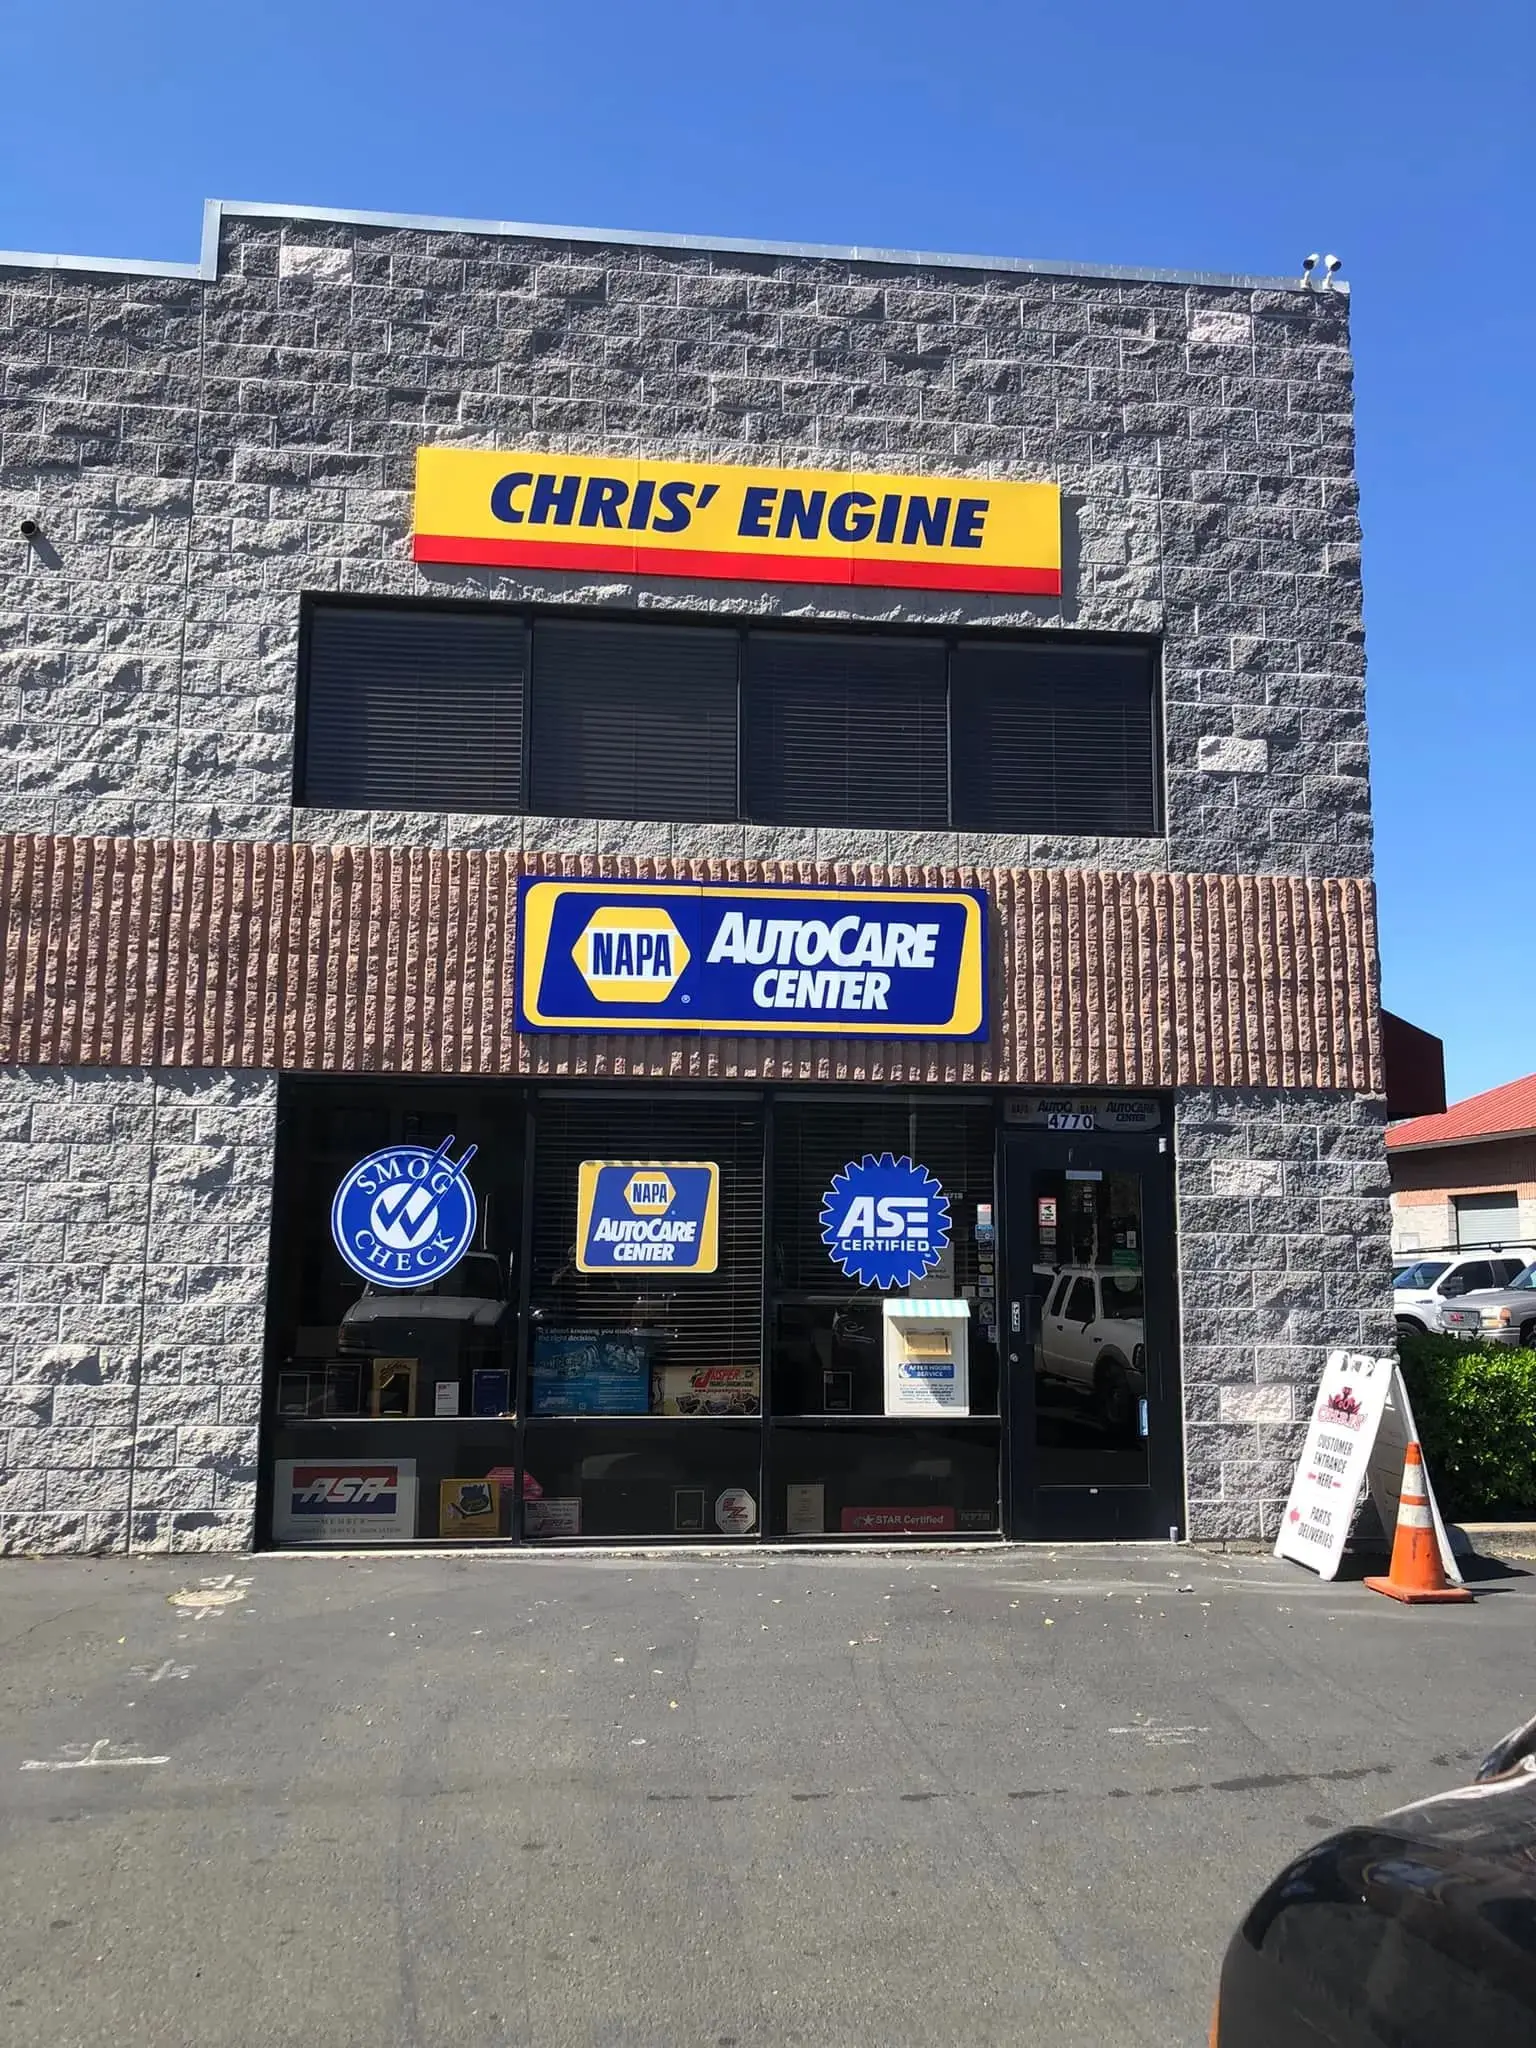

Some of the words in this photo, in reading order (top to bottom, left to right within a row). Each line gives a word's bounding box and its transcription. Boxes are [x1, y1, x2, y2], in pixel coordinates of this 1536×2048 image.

[490, 471, 719, 534] CHRIS'
[737, 487, 990, 549] ENGINE
[706, 911, 940, 969] AUTOCARE
[592, 932, 673, 977] NAPA
[753, 969, 891, 1010] CENTER
[1049, 1115, 1093, 1129] 4770
[356, 1157, 454, 1195] SMOG
[633, 1183, 667, 1203] NAPA
[593, 1217, 697, 1242] AUTOCARE
[837, 1196, 929, 1238] ASE
[354, 1229, 455, 1271] CHECK
[613, 1243, 675, 1261] CENTER
[841, 1239, 930, 1252] CERTIFIED
[1318, 1434, 1354, 1456] CUSTOMER
[1313, 1451, 1347, 1474] ENTRANCE
[300, 1477, 390, 1502] ASA
[1316, 1472, 1333, 1488] HERE
[876, 1515, 900, 1524] STAR
[903, 1514, 944, 1525] Certified
[1310, 1506, 1332, 1526] PARTS
[1298, 1522, 1335, 1549] DELIVERIES
